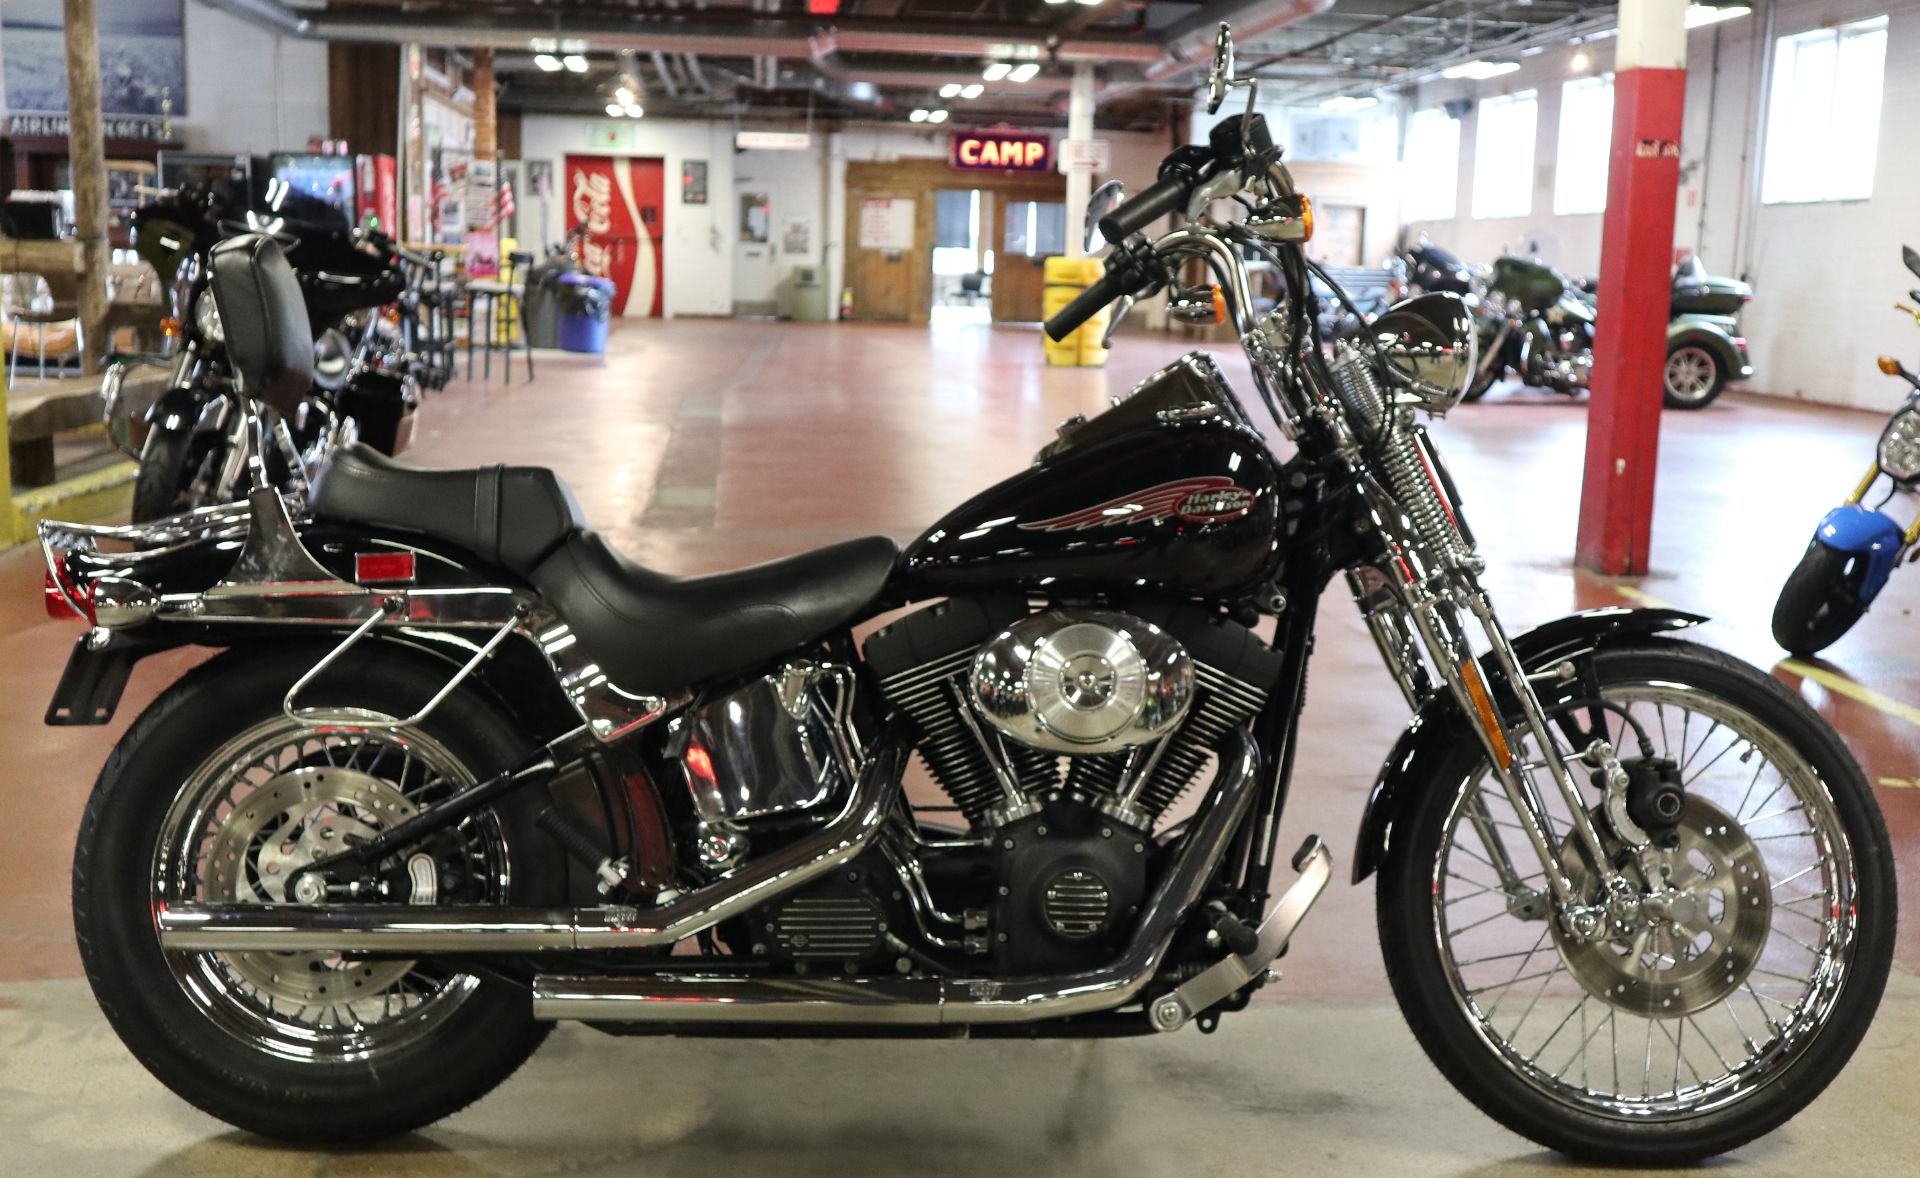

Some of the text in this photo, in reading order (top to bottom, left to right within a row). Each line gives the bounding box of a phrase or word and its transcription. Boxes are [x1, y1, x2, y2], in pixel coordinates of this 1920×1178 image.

[11, 115, 70, 136] AIRLIN
[959, 139, 1045, 167] CAMP
[1180, 500, 1251, 514] Davison
